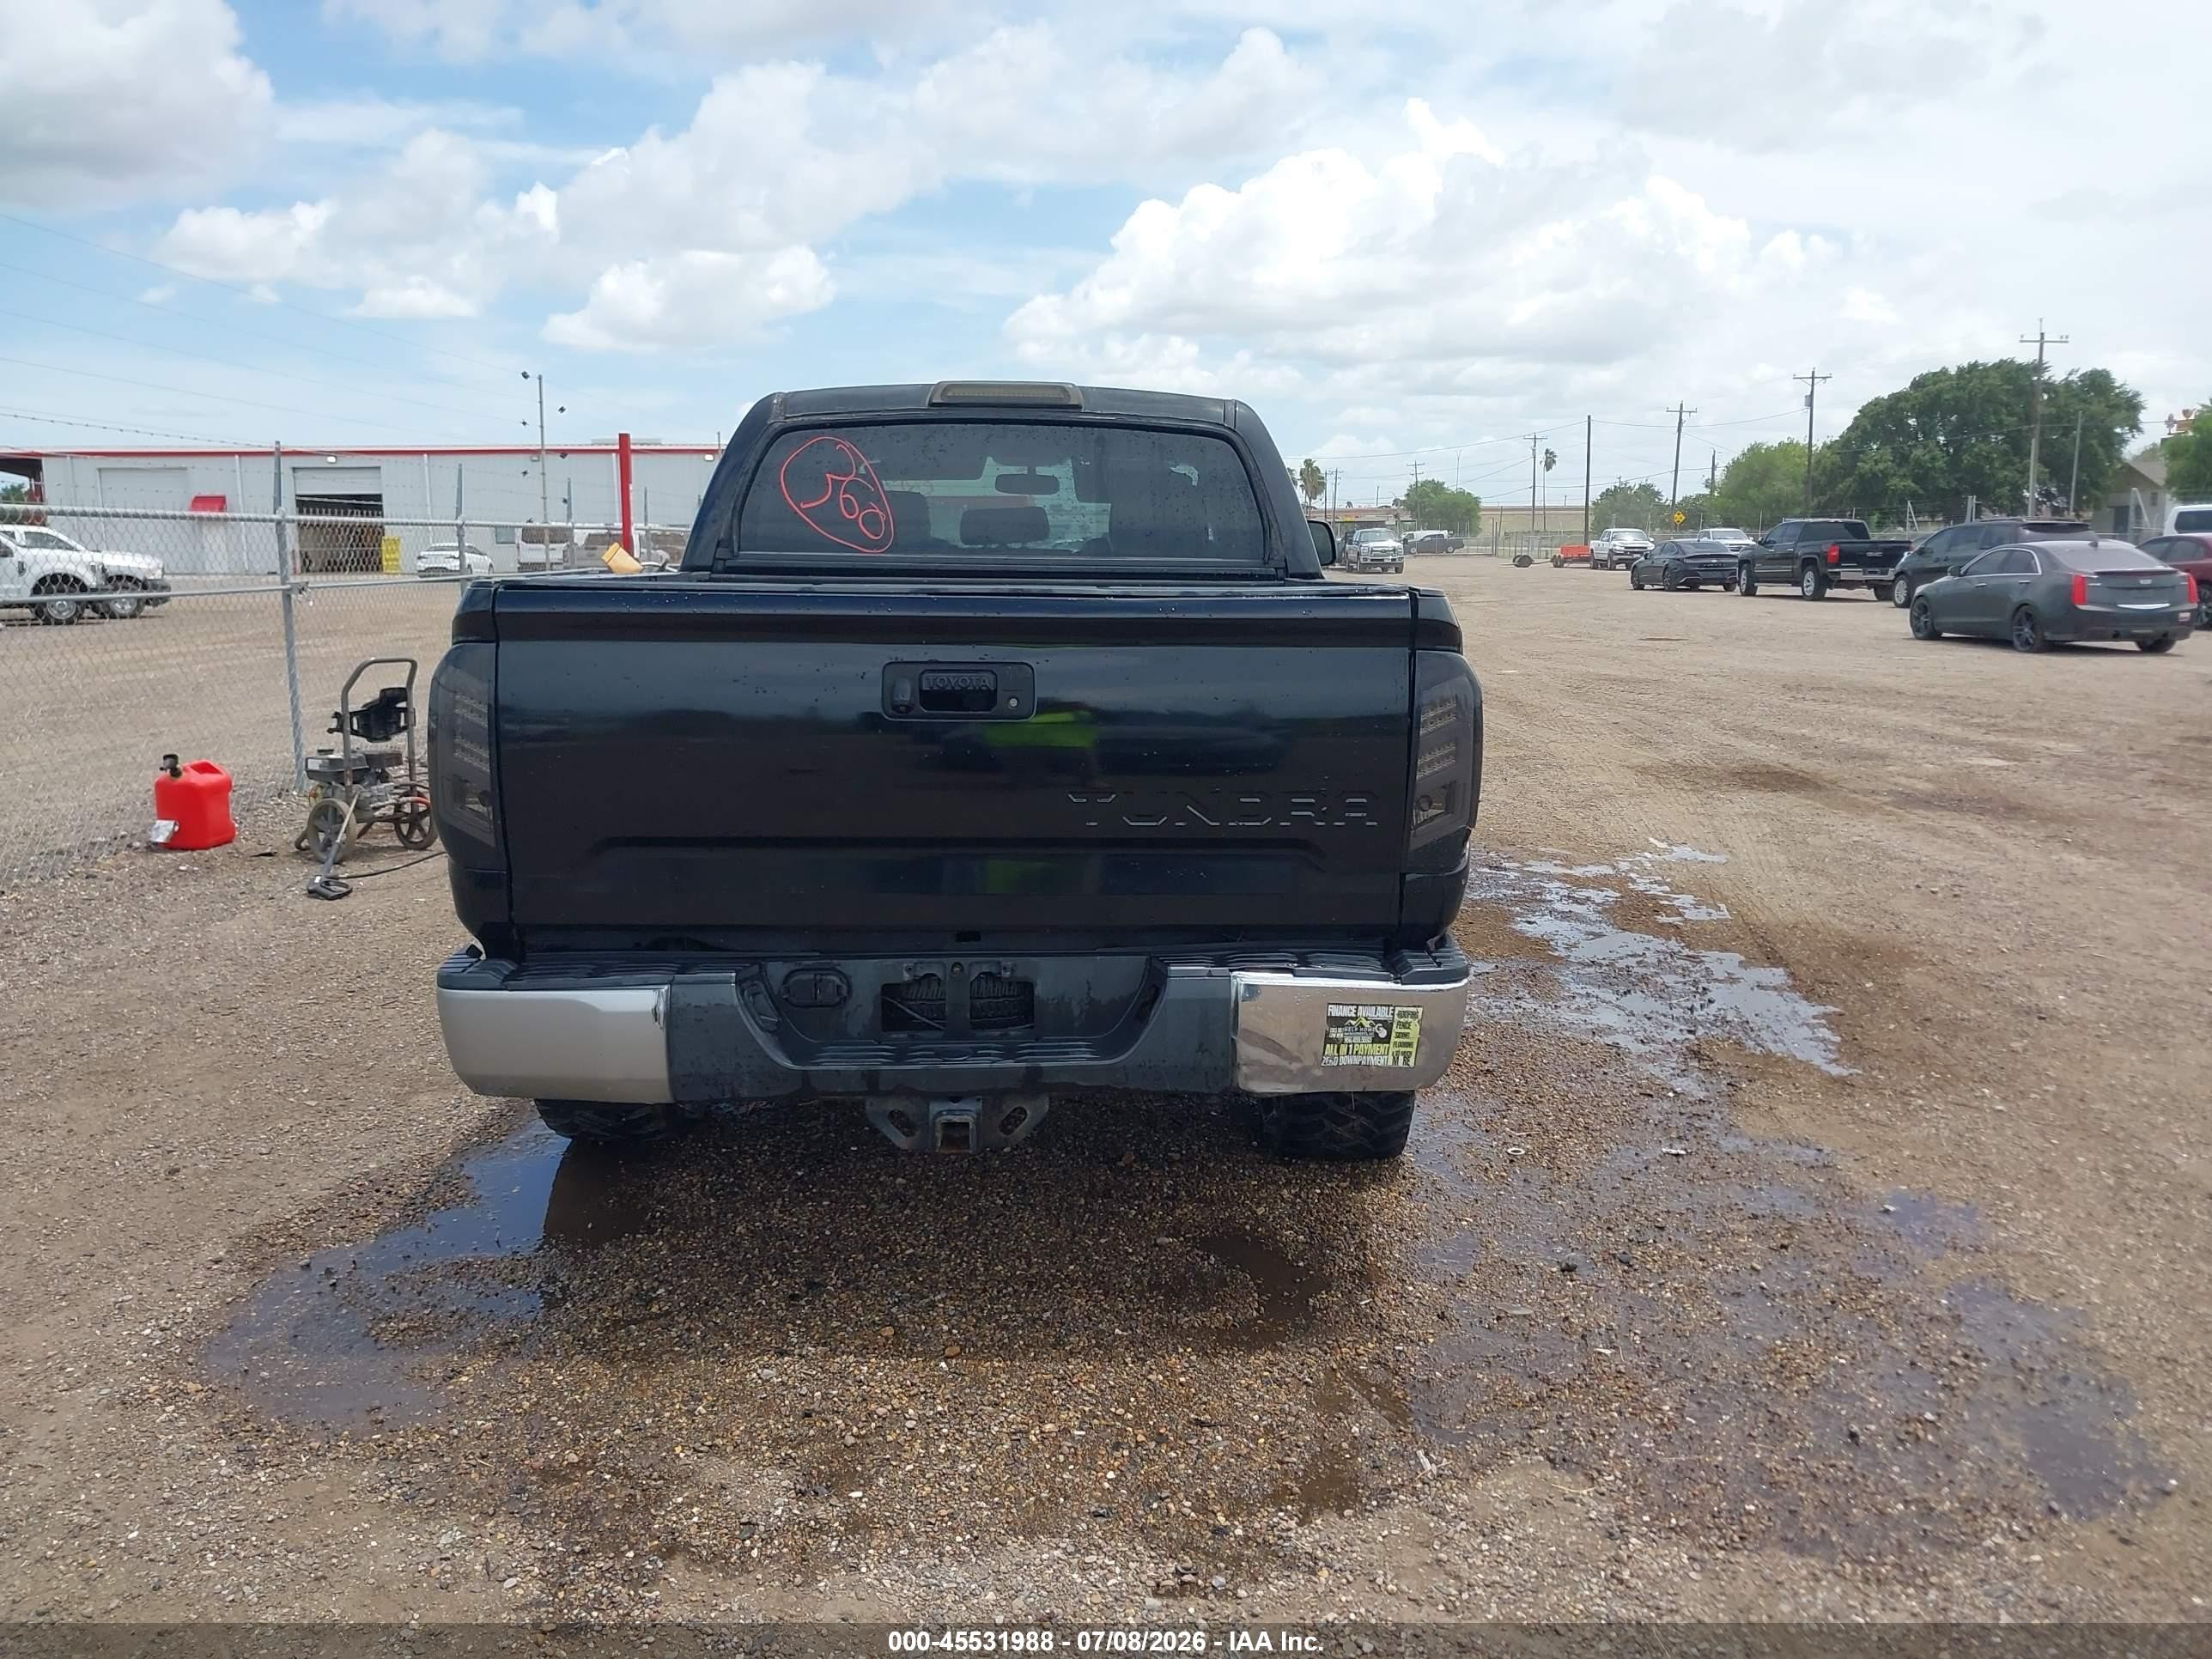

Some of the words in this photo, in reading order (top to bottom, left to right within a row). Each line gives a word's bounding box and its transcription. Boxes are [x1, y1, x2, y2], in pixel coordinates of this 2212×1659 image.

[927, 675, 989, 690] TOYOTA
[1067, 791, 1377, 826] TUNDRA
[1328, 1005, 1357, 1017] FINANCE
[1357, 1006, 1394, 1018] AVAILABLE
[1325, 1043, 1338, 1055] ALL
[1340, 1044, 1347, 1055] IN
[1348, 1044, 1353, 1054] 1
[1353, 1044, 1389, 1055] PAYMENT
